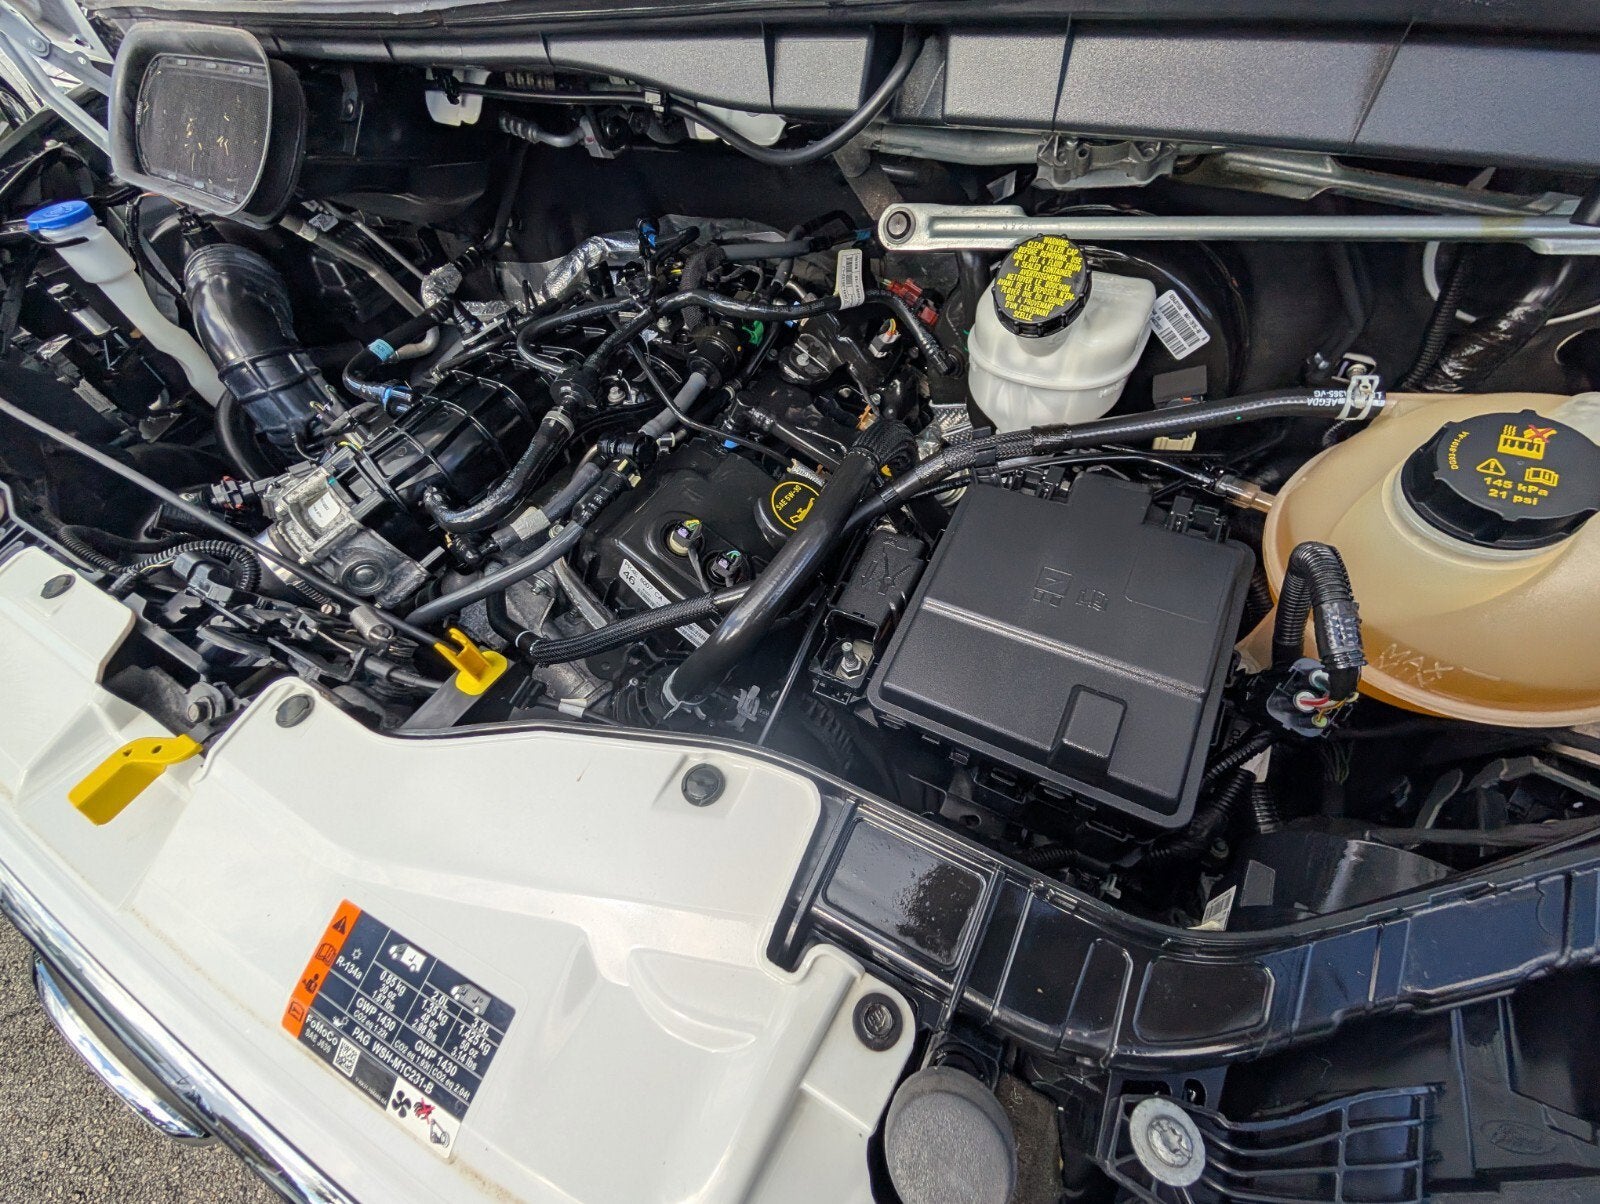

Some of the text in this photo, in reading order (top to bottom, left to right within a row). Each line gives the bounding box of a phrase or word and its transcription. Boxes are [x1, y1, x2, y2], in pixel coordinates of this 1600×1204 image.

[1018, 246, 1038, 254] BEFORE
[1071, 256, 1083, 264] USE
[1027, 241, 1079, 256] CLEAN FILLER CAP
[1013, 252, 1026, 260] ONLY
[1047, 259, 1064, 268] FLUID
[1065, 263, 1082, 272] FROM
[1021, 261, 1041, 270] SEALED
[1024, 284, 1032, 292] LE
[1035, 278, 1042, 286] LE
[1025, 298, 1055, 310] PROVENANT
[1484, 477, 1548, 496] 145 kPa
[775, 498, 787, 510] SAE
[1488, 488, 1538, 505] 21 psi
[623, 571, 636, 586] 46
[1379, 643, 1454, 683] MAX
[336, 955, 362, 980] R-134a
[387, 990, 397, 1000] oz
[395, 981, 407, 997] kg
[384, 999, 395, 1012] lbs
[431, 990, 449, 1010] 2.0L
[354, 1010, 367, 1023] CO2
[356, 997, 396, 1031] GWP 1430
[421, 1000, 449, 1026] 1.35 kg
[421, 1012, 439, 1031] 48 oz
[305, 1028, 318, 1043] SAE
[306, 1014, 338, 1046] FoMoCo
[425, 1030, 438, 1042] lbs
[472, 1018, 490, 1038] 3.5L
[394, 1040, 409, 1053] CO2
[458, 1025, 491, 1056] 1.425 kg
[460, 1040, 479, 1059] 50 oz
[352, 1026, 371, 1046] PAG
[372, 1041, 434, 1094] WSH-M1C231-B
[414, 1040, 458, 1077] GWP 1430
[451, 1046, 478, 1071] 3.14 lbs
[432, 1067, 446, 1081] CO2
